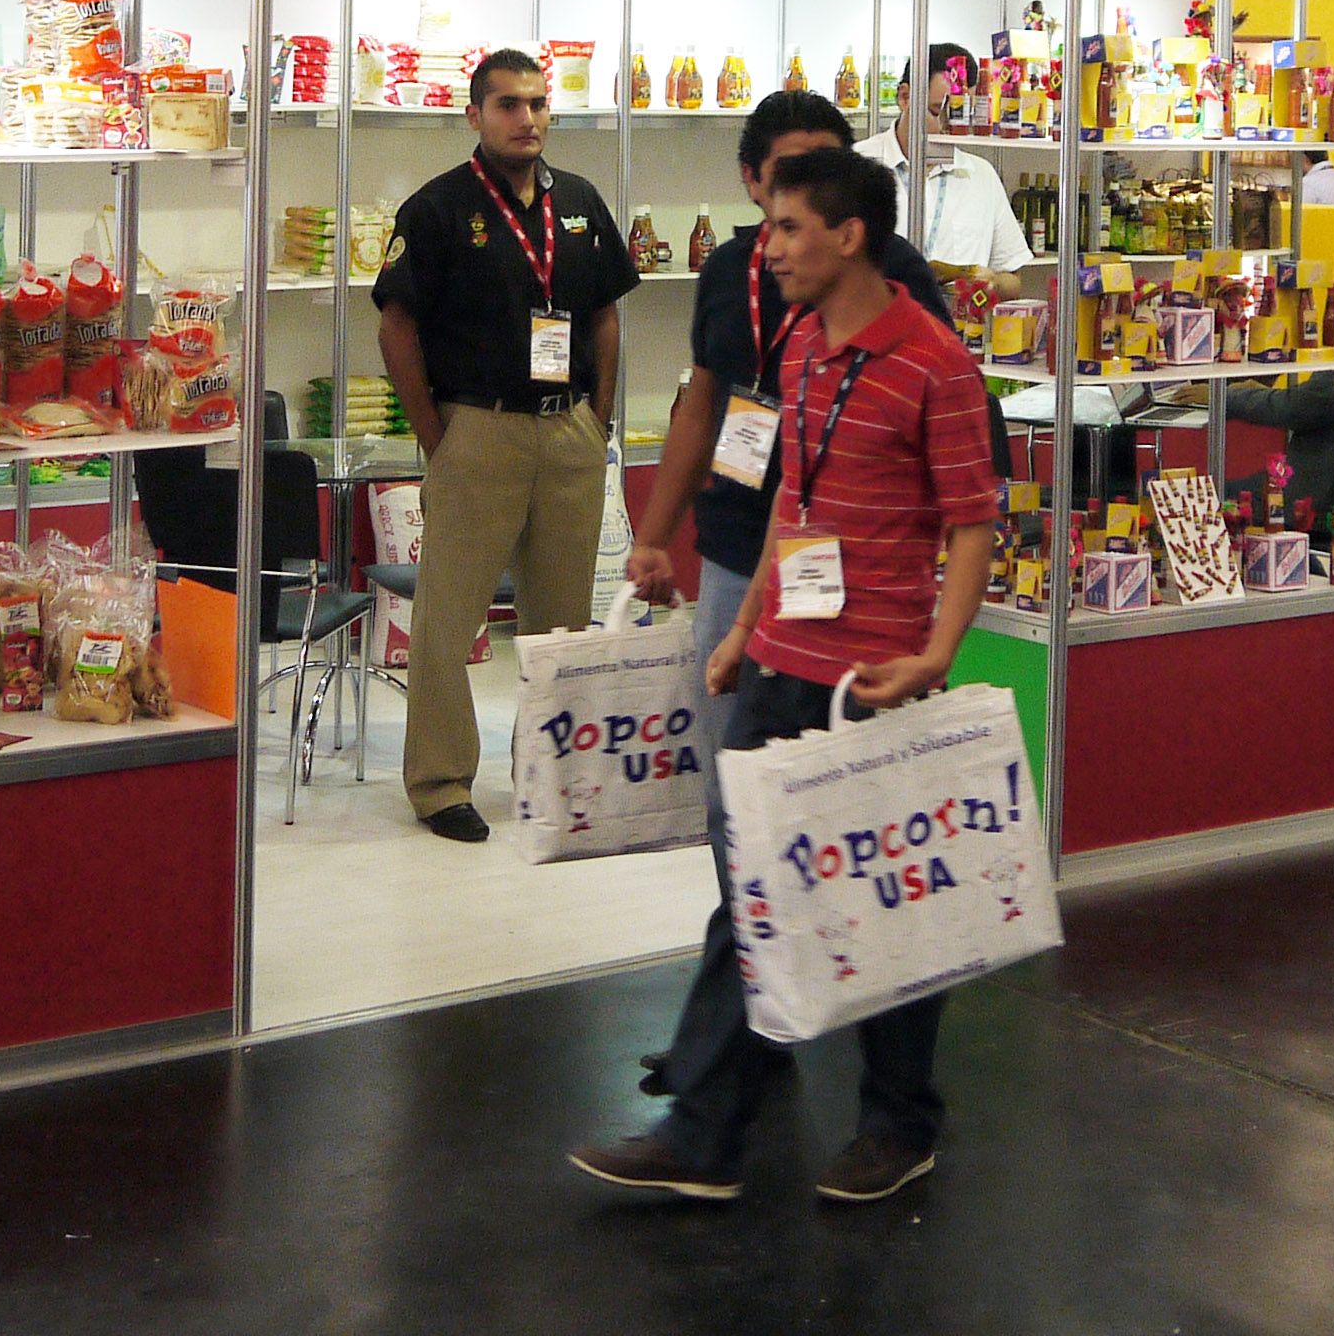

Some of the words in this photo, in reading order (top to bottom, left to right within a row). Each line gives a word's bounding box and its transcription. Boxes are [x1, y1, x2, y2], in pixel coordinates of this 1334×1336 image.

[623, 746, 701, 783] USA
[780, 761, 1021, 890] Popcorn!
[874, 856, 958, 909] USA
